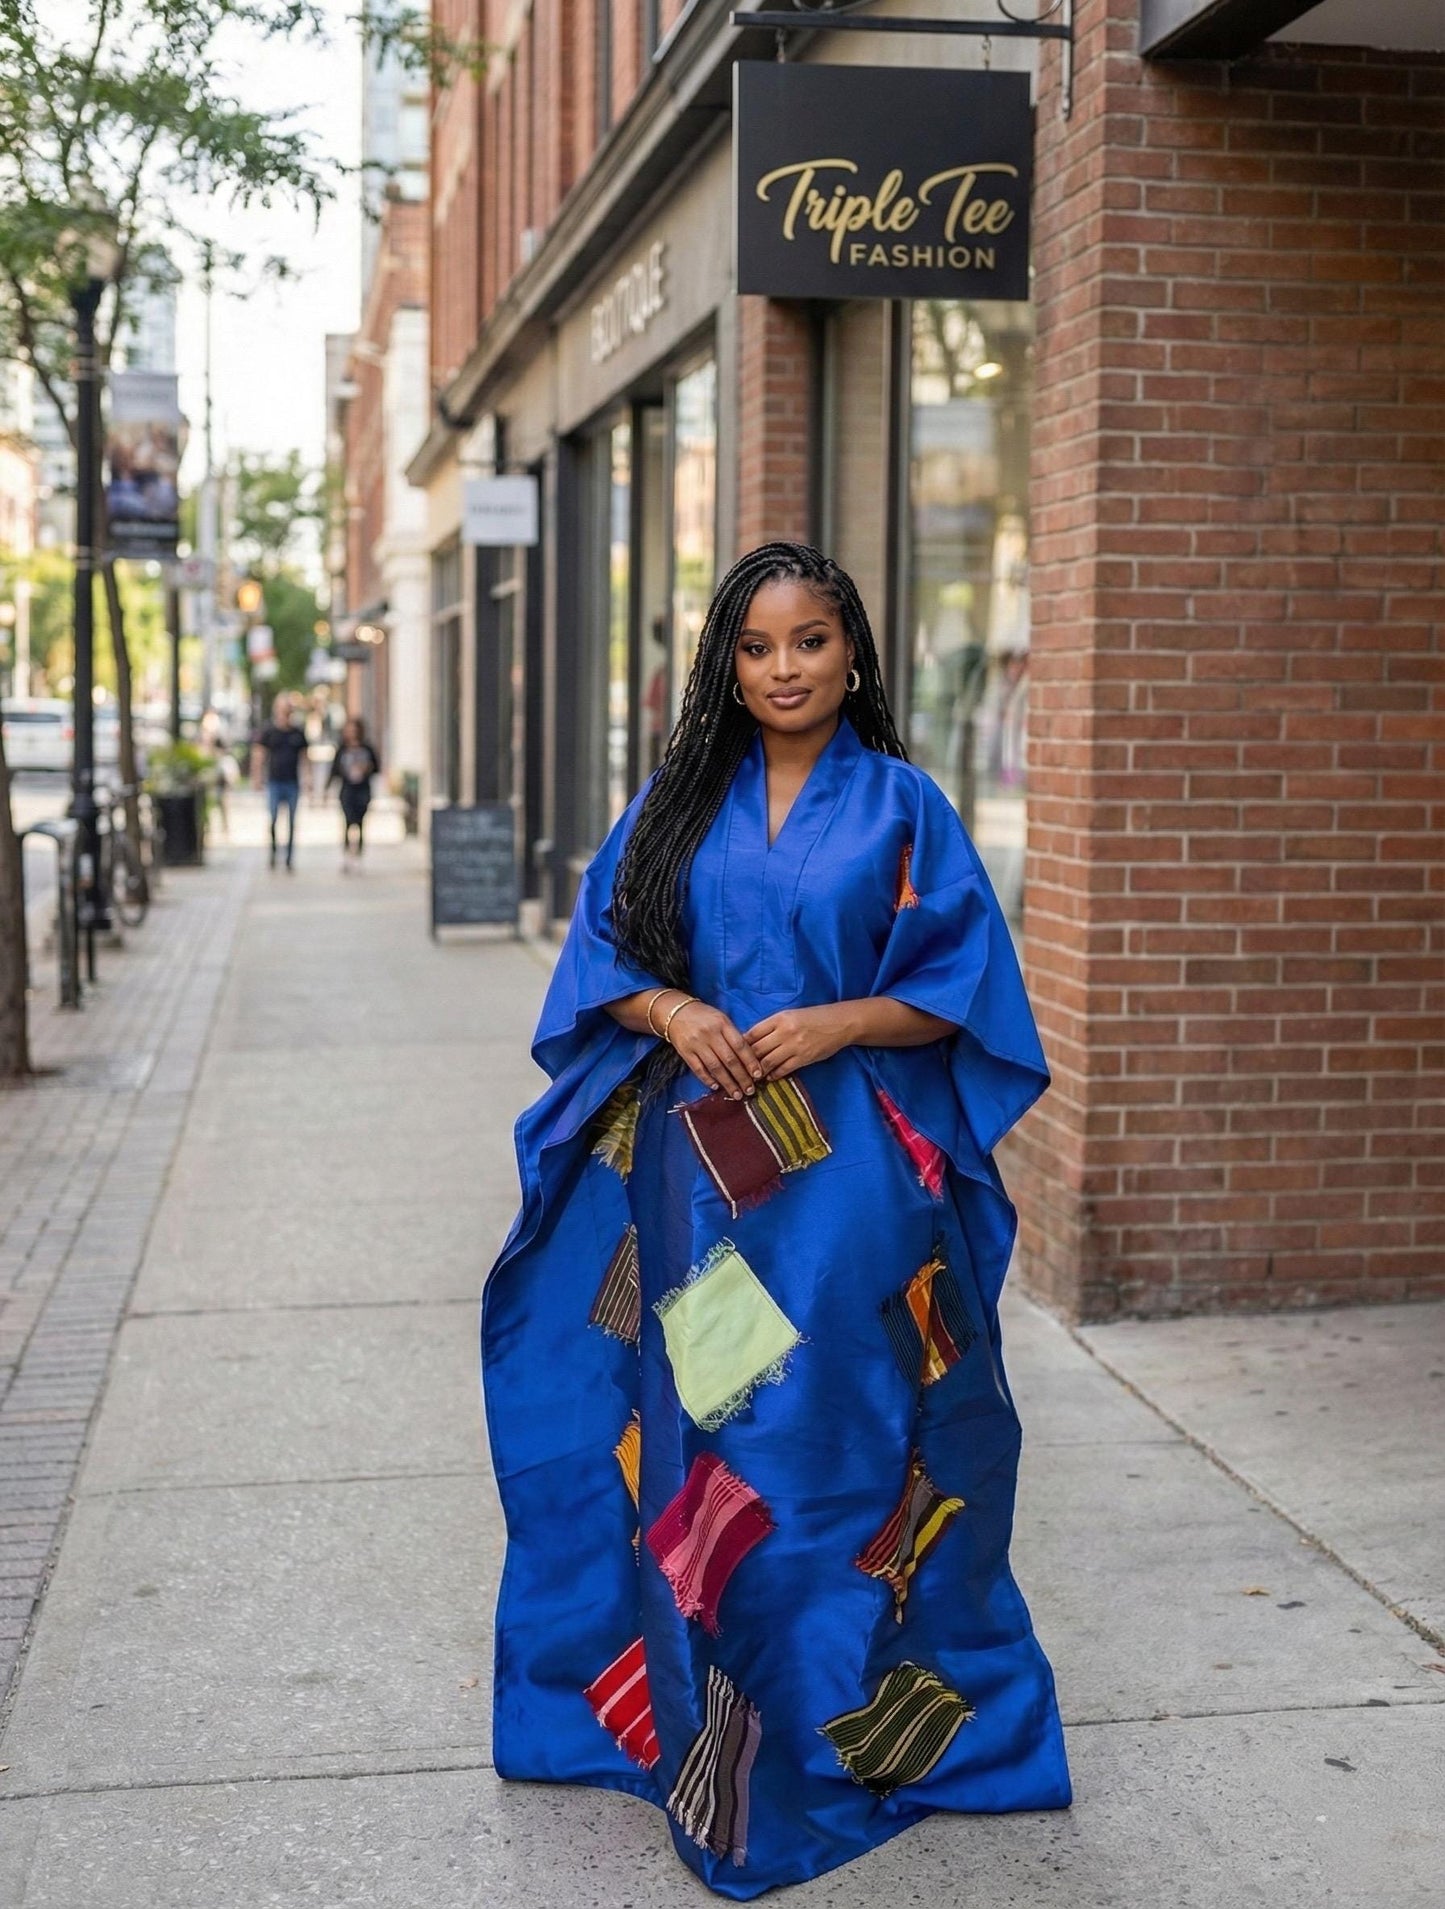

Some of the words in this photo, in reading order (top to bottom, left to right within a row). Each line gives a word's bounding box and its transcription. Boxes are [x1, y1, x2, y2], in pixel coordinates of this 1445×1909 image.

[756, 158, 920, 264] Triple
[918, 162, 1018, 243] Tee
[850, 243, 995, 269] FASHION
